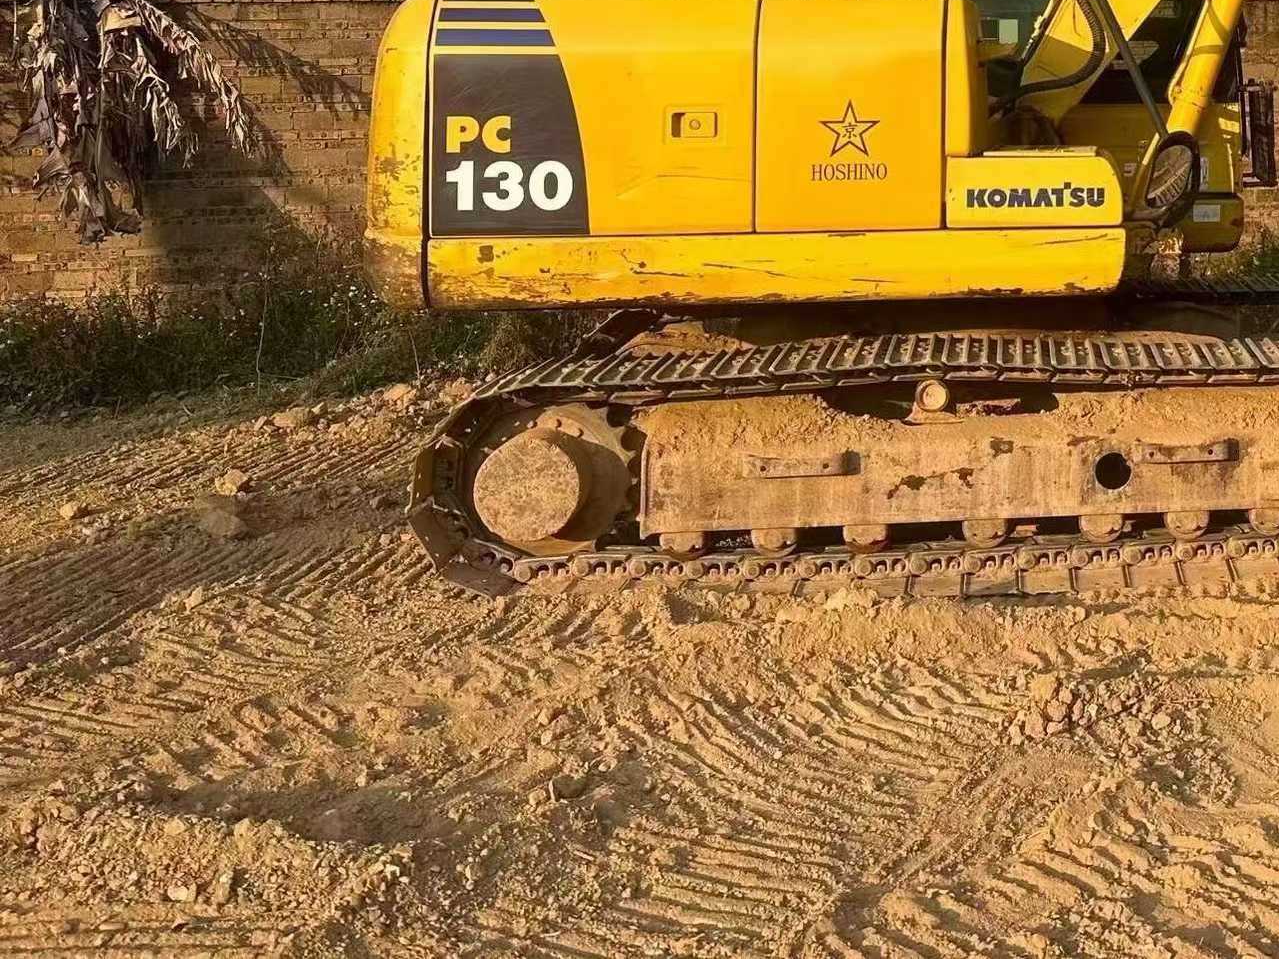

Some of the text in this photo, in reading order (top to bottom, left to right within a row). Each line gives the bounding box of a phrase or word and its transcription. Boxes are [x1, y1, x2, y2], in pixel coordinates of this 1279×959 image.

[446, 115, 512, 154] PC
[446, 160, 573, 211] 130
[811, 162, 888, 181] HOSHINO
[966, 182, 1105, 208] KOMATSU
